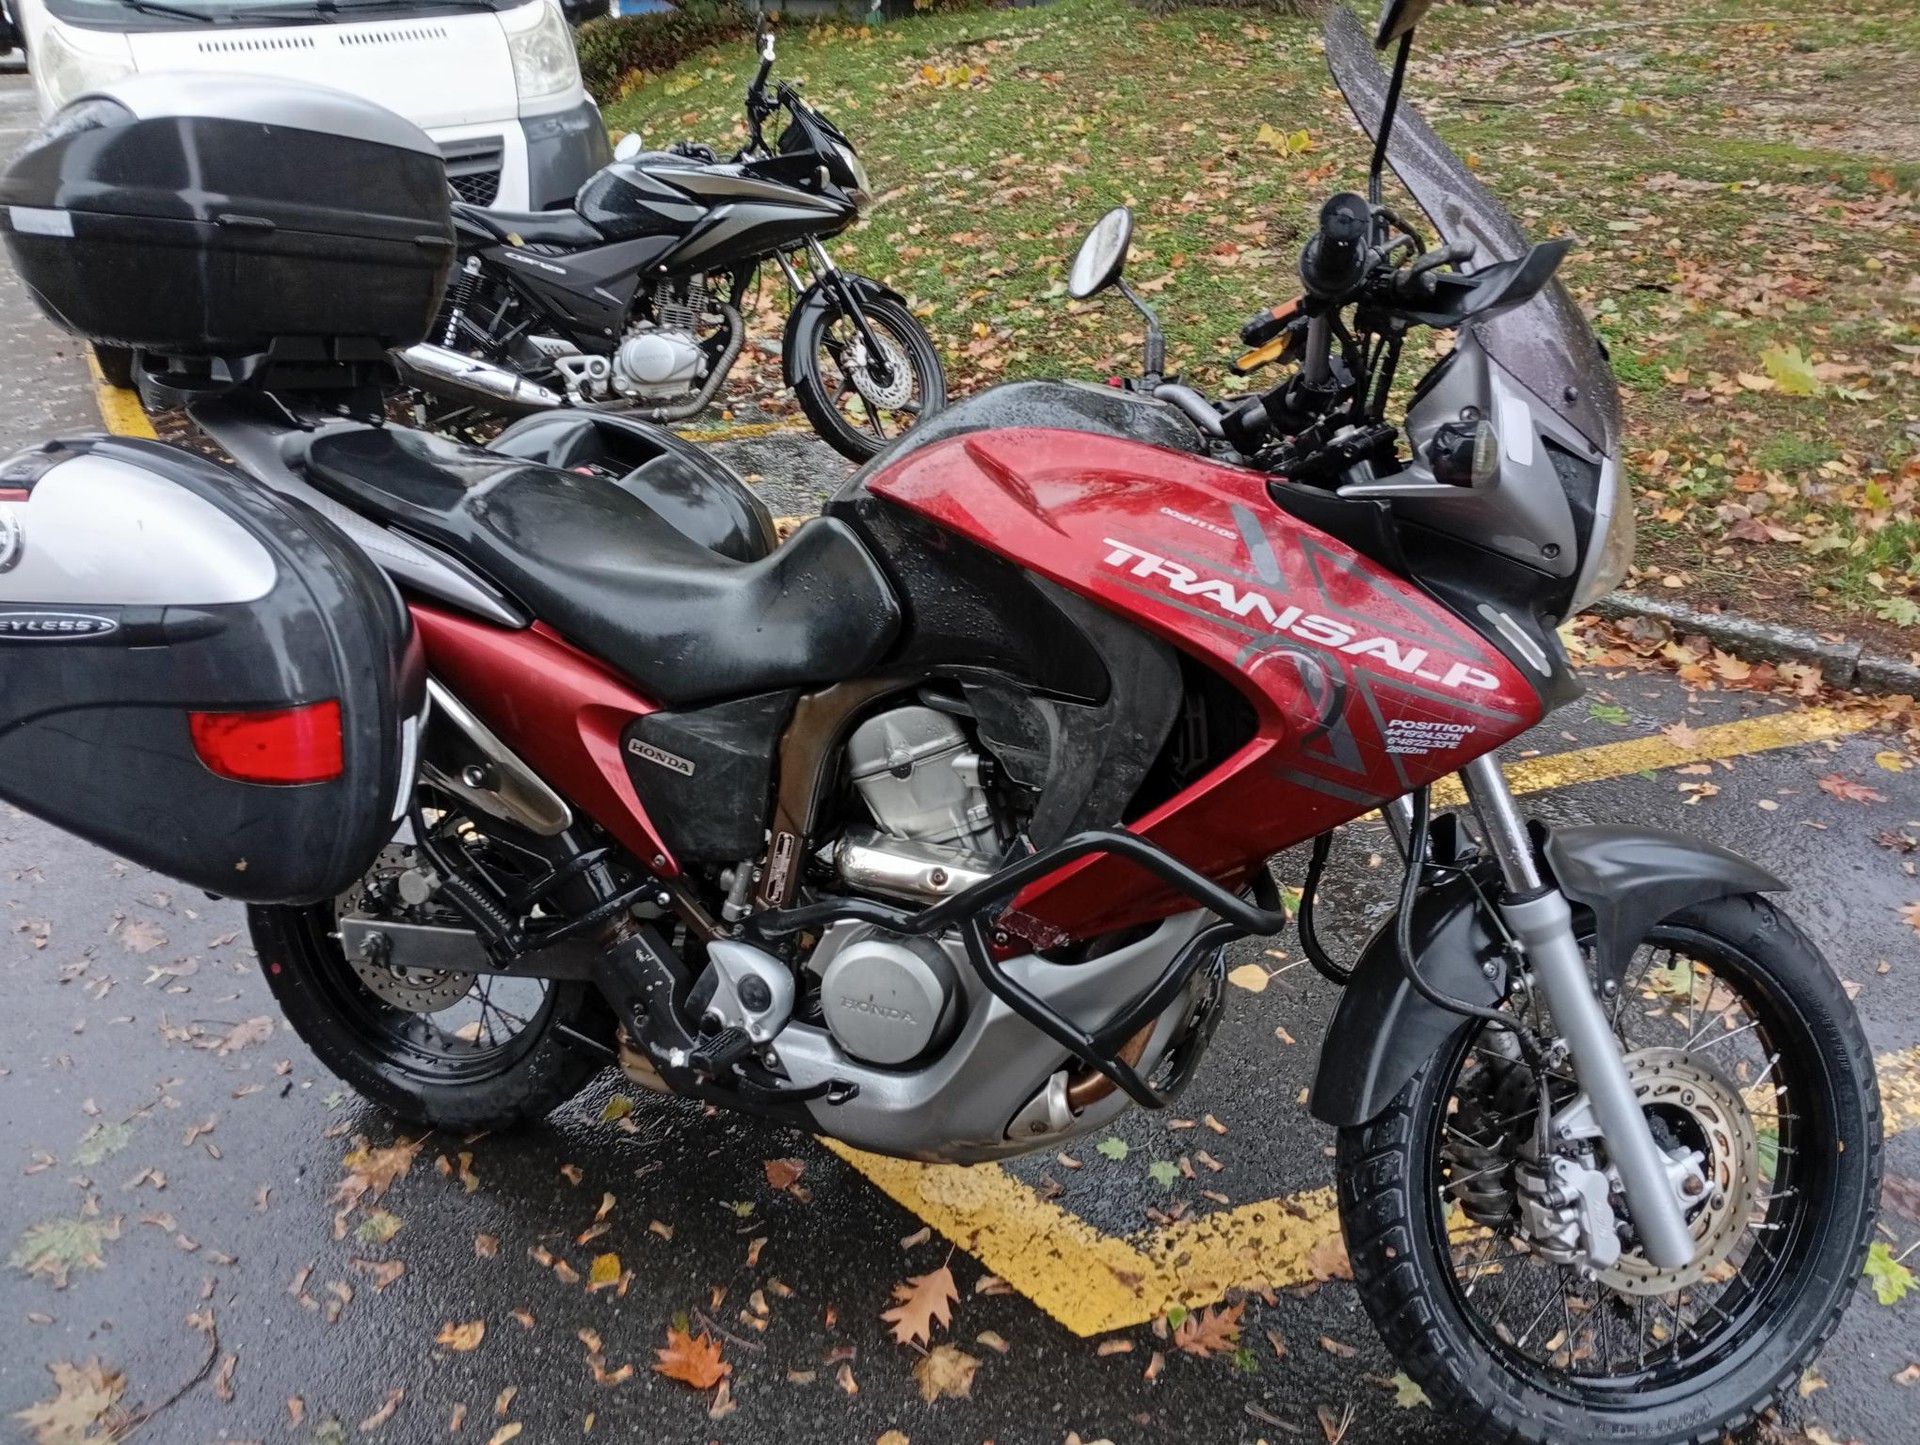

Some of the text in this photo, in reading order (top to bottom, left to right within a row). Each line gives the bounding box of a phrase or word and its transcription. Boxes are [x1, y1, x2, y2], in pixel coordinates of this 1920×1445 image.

[1102, 537, 1500, 690] TRANSALP
[1388, 719, 1476, 733] POSITION
[632, 742, 690, 772] HONDA
[841, 996, 917, 1025] HONDA
